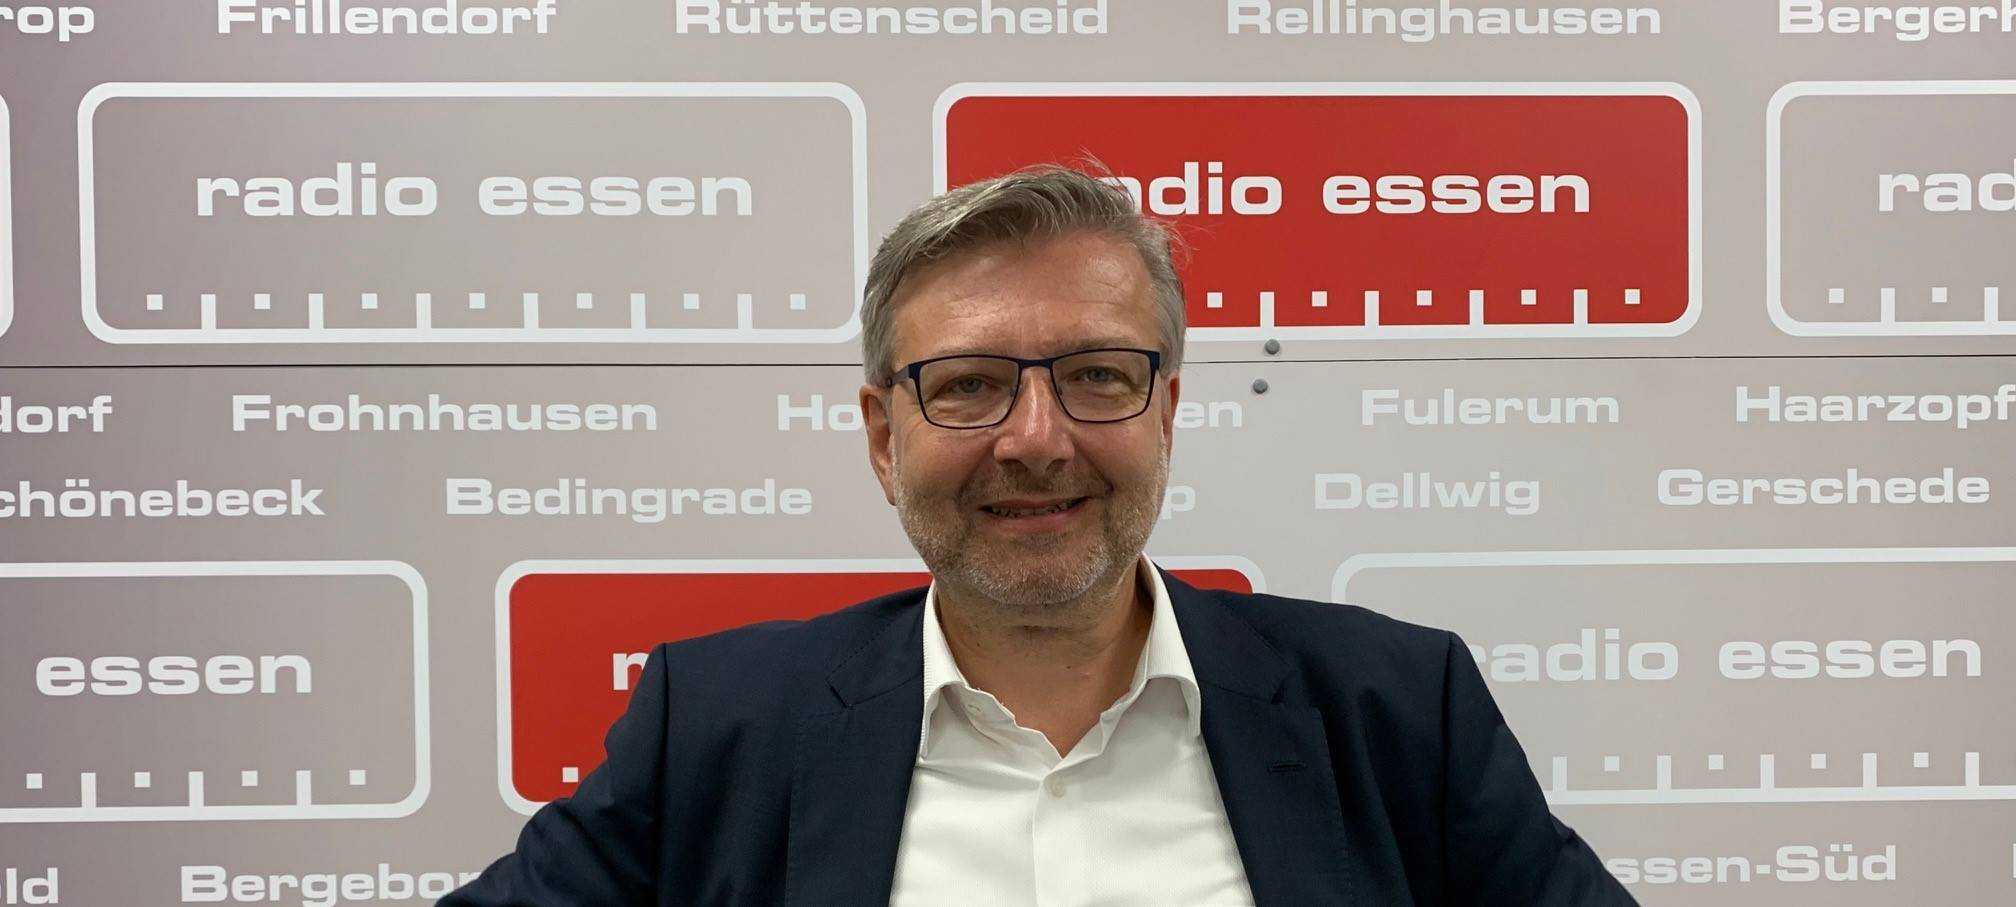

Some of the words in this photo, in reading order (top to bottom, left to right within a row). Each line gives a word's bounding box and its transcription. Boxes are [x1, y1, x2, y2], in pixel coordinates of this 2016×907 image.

[217, 0, 557, 35] Frillendorf
[676, 0, 1109, 35] Rüttenscheid
[1228, 0, 1662, 43] Rellinghausen
[197, 162, 438, 217] radio
[479, 176, 753, 217] essen
[1323, 175, 1590, 215] essen
[233, 394, 657, 432] Frohnhausen
[1362, 388, 1619, 426] Fulerum
[1736, 384, 2016, 429] Haarzopf
[446, 478, 813, 524] Bedingrade
[1315, 472, 1541, 516] Dellwig
[1657, 468, 1990, 506] Gerschede
[35, 655, 312, 697] essen
[1719, 639, 1982, 680] essen
[1604, 844, 1897, 884] ssen-Süd
[0, 867, 59, 905] ld
